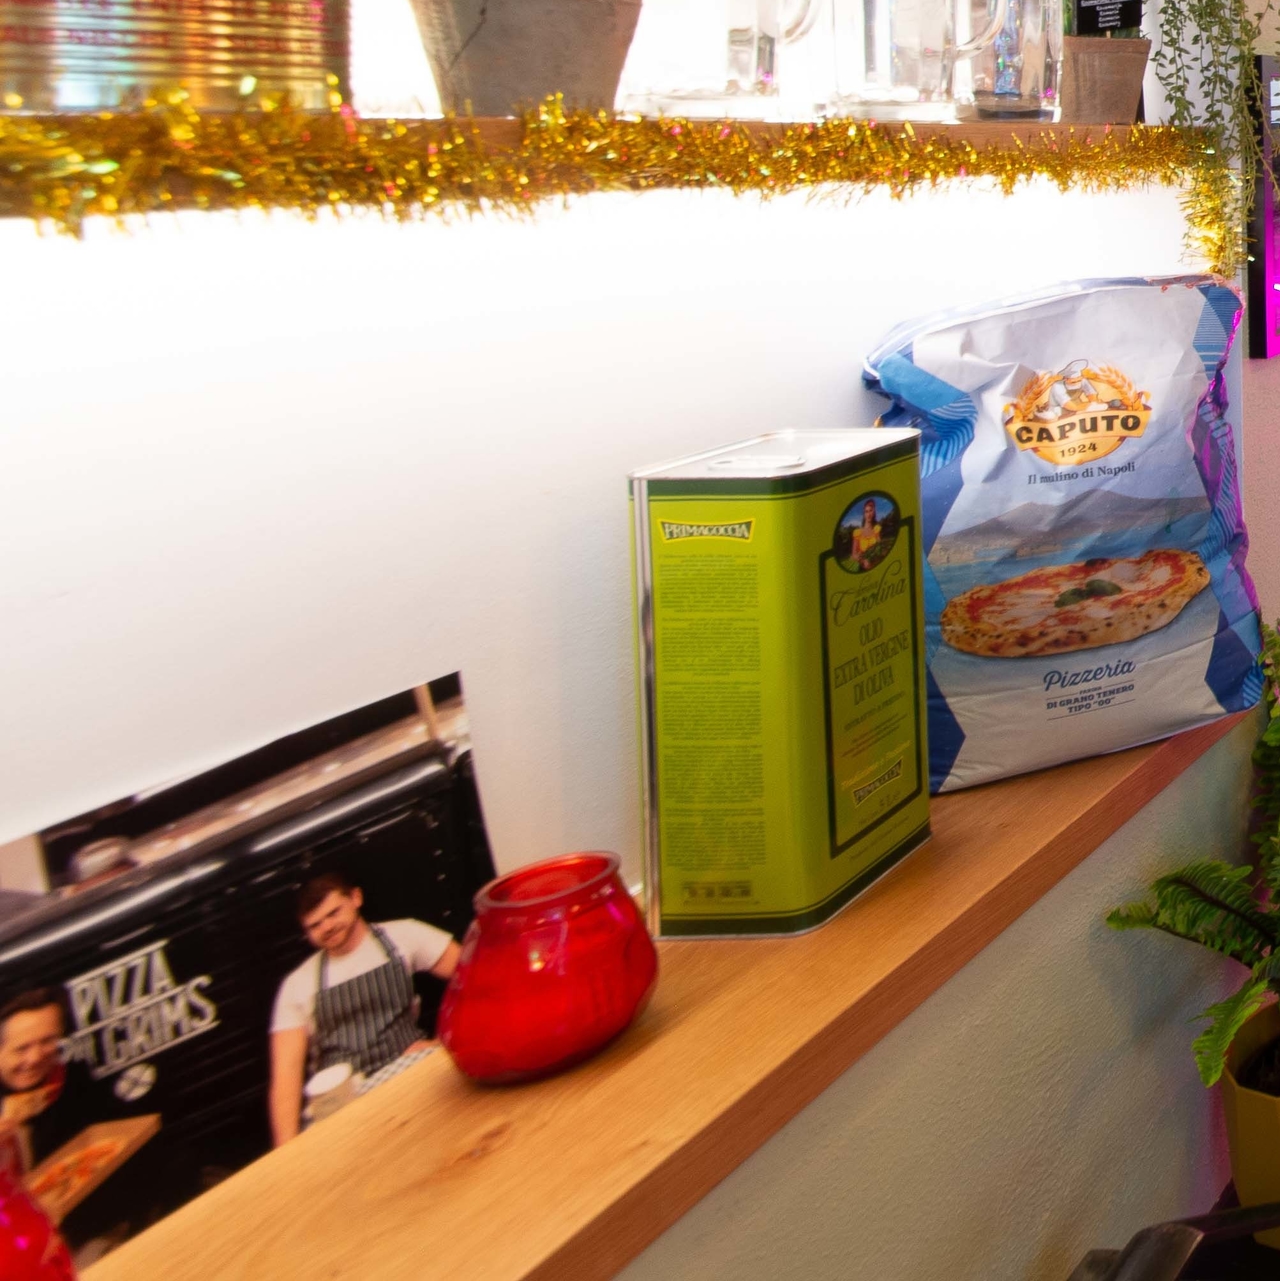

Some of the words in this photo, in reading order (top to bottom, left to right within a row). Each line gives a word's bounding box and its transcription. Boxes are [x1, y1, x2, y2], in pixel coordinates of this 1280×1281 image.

[1015, 413, 1141, 444] CAPUTO
[1060, 441, 1097, 458] 1924
[1028, 474, 1037, 485] Il
[1040, 469, 1079, 484] mulino
[1081, 467, 1094, 478] di
[1098, 461, 1136, 478] Napoli
[664, 521, 750, 540] PRIMAGOCCIA
[829, 559, 906, 628] Carolina
[858, 616, 883, 647] OLIO
[833, 652, 868, 690] EXTRA
[867, 629, 910, 677] VERGINE
[853, 680, 866, 706] DI
[865, 665, 894, 699] OLIVA
[1043, 659, 1137, 692] Pizzeria
[1046, 701, 1058, 710] DI
[1059, 694, 1095, 708] GRANO
[1096, 684, 1135, 699] TENERO
[1067, 703, 1092, 713] TIPO
[69, 949, 177, 1032] PIZZA
